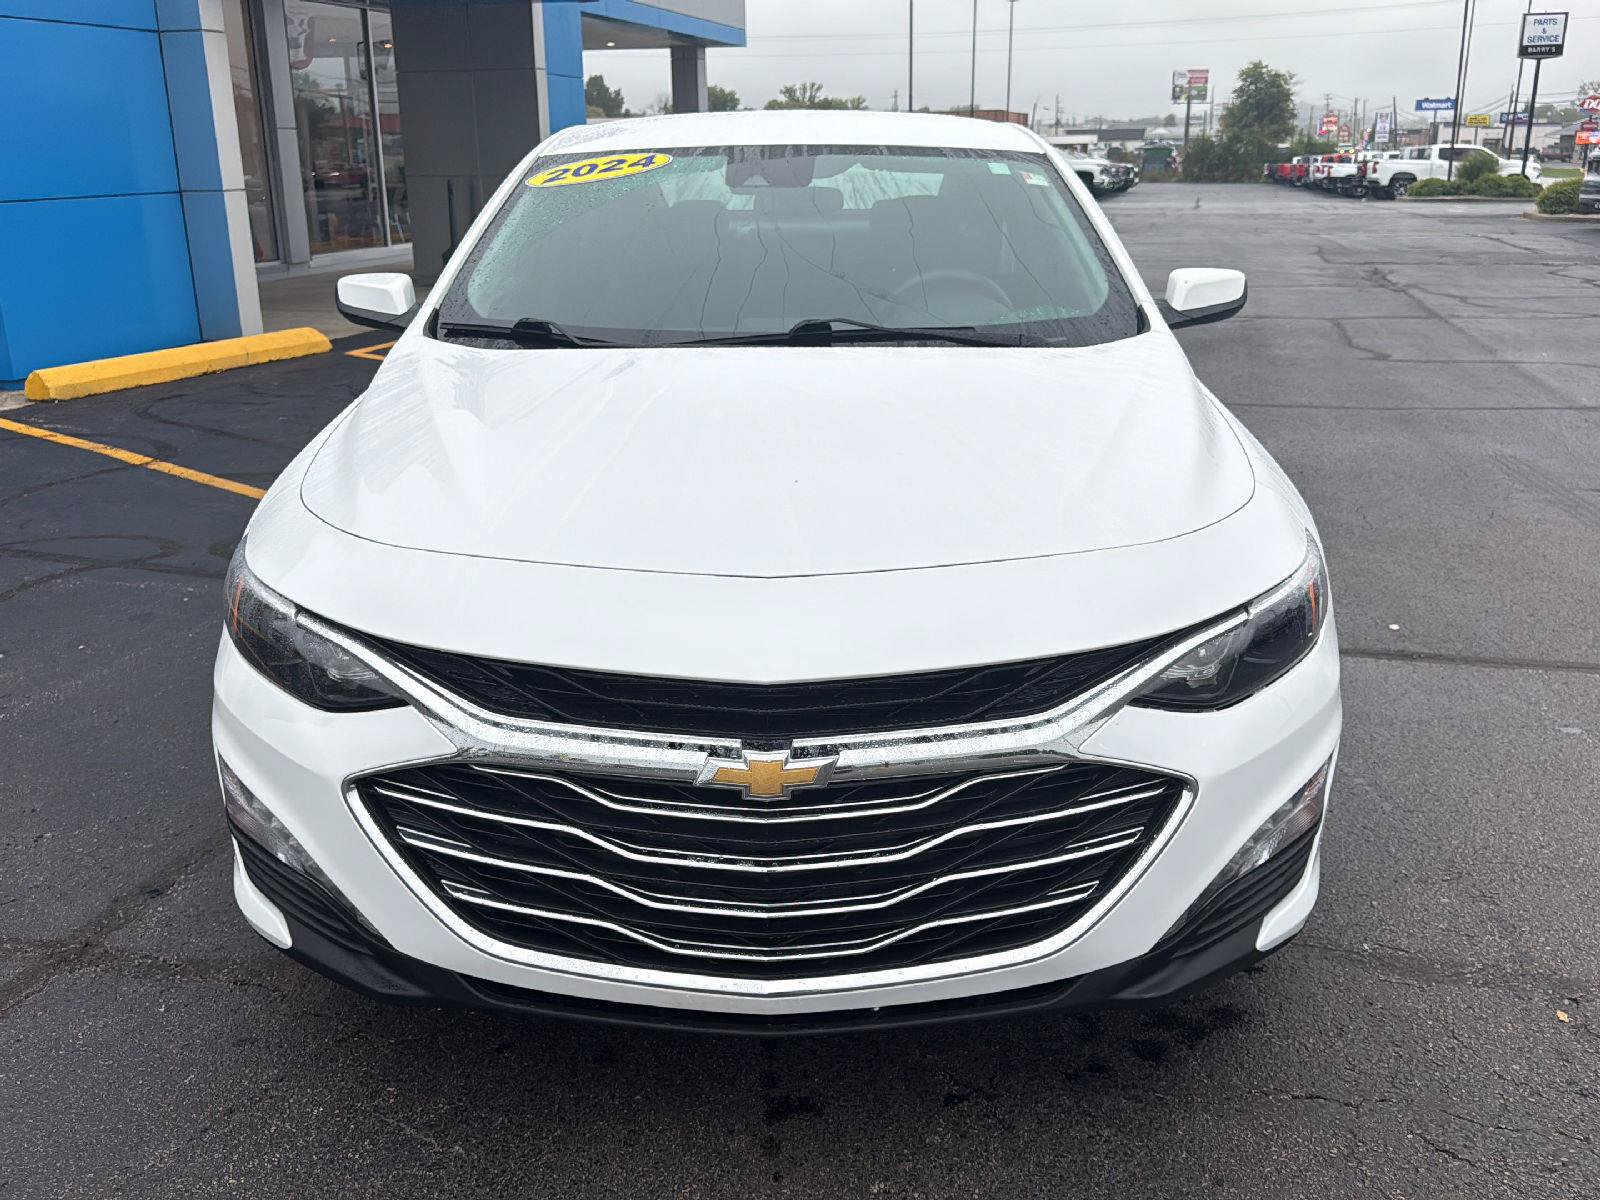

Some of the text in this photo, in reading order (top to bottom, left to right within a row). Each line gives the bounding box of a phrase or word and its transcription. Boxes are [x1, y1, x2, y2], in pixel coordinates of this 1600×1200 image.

[1533, 18, 1558, 26] PARTS
[1527, 34, 1560, 43] SERVICE
[1421, 100, 1453, 109] Walmart
[541, 154, 656, 184] 2024
